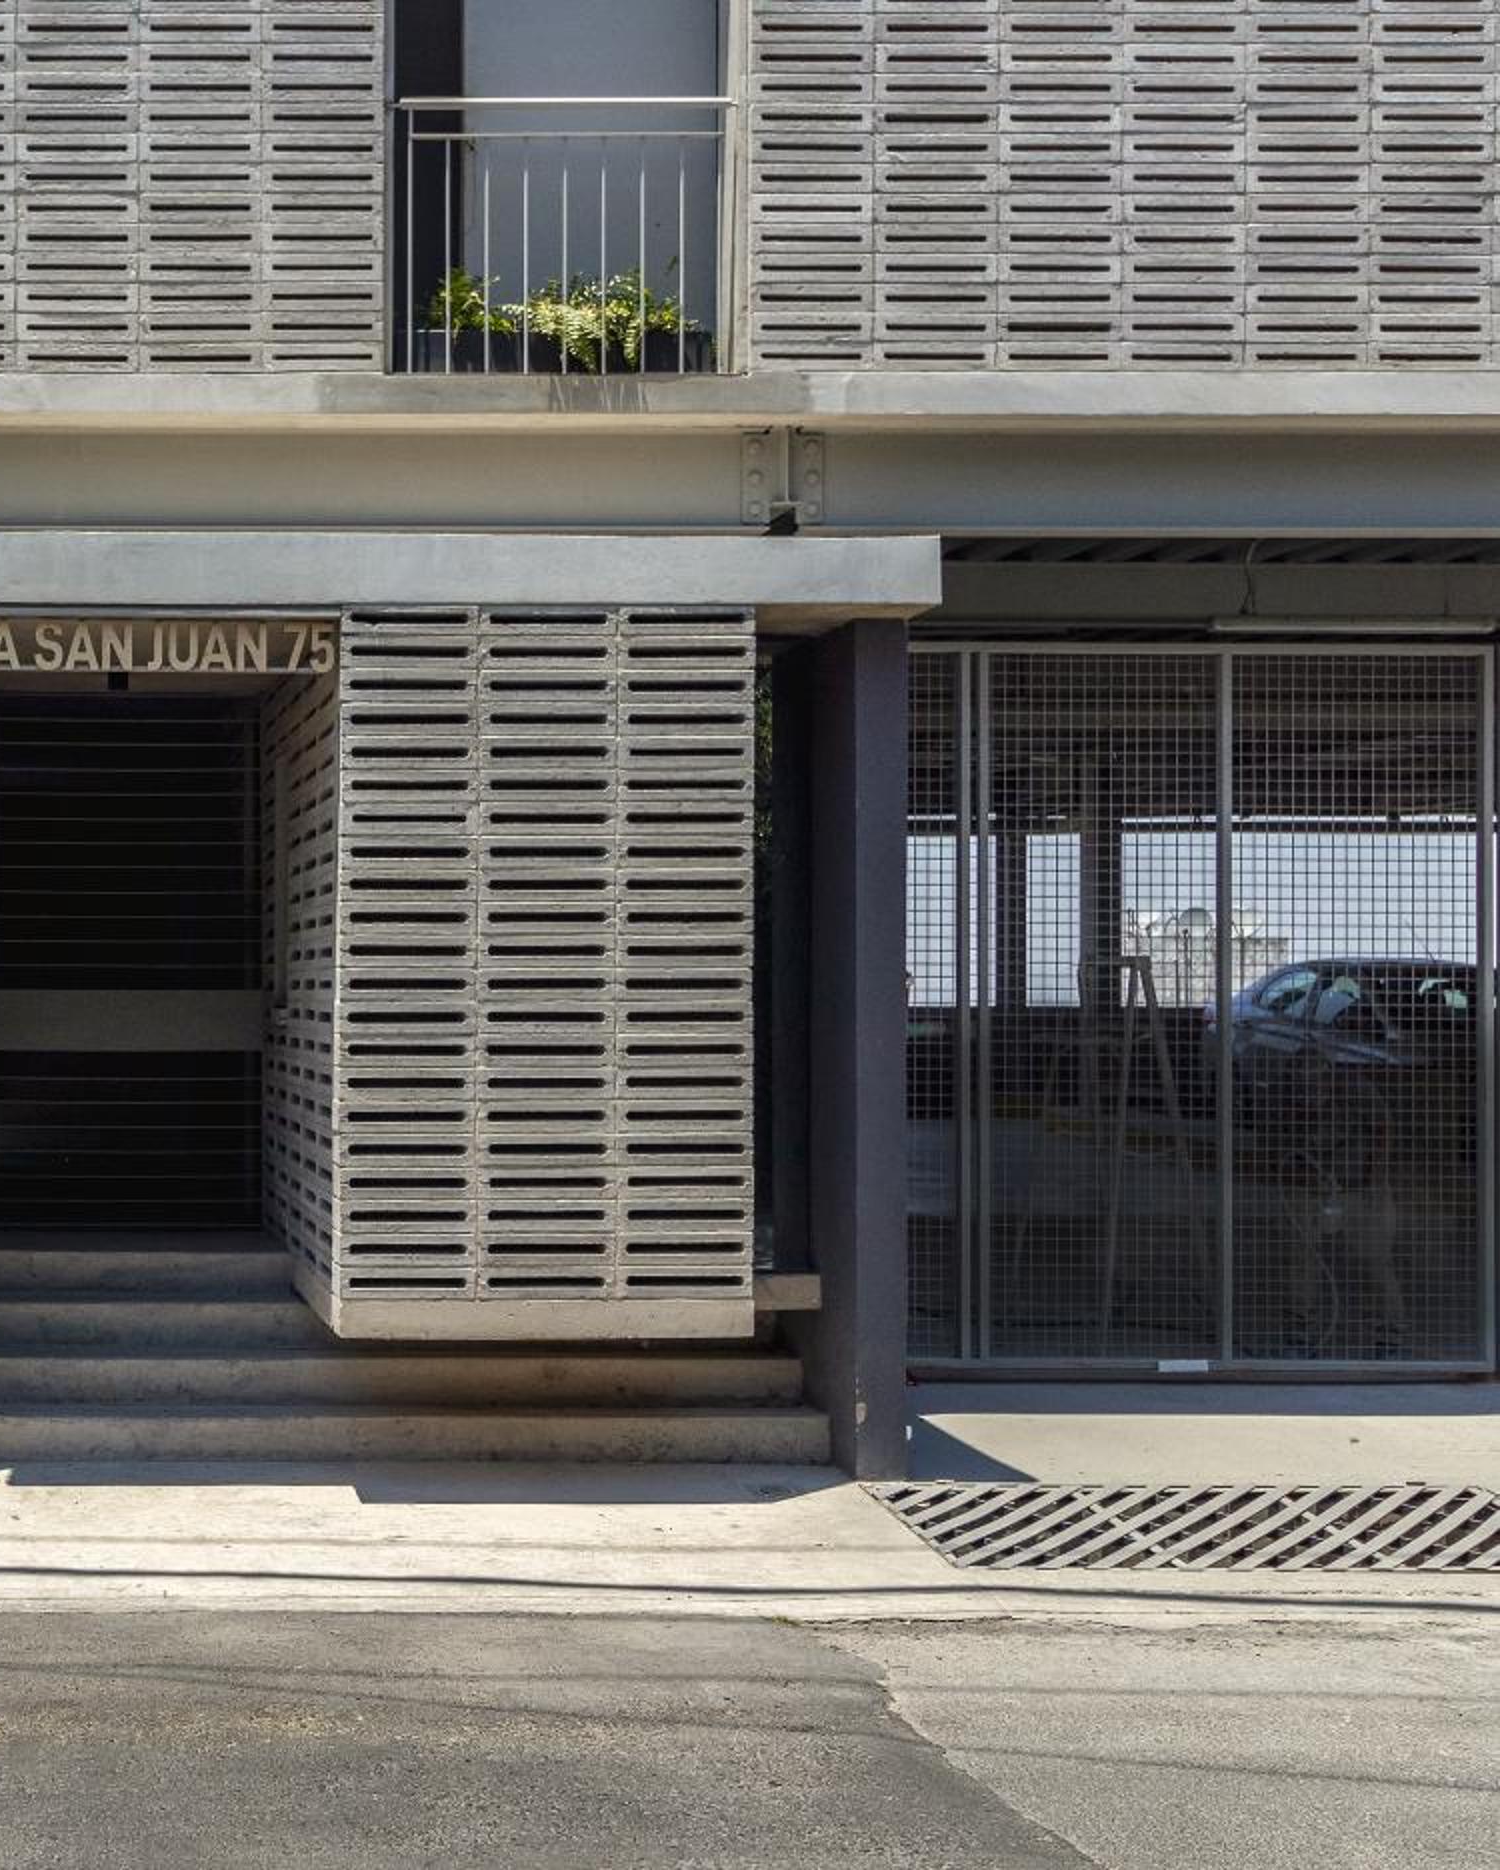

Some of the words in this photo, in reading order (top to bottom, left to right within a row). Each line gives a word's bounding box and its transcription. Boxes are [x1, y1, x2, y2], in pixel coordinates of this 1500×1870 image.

[34, 622, 133, 672] SAN
[147, 622, 268, 672] JUAN
[283, 624, 336, 673] 75
